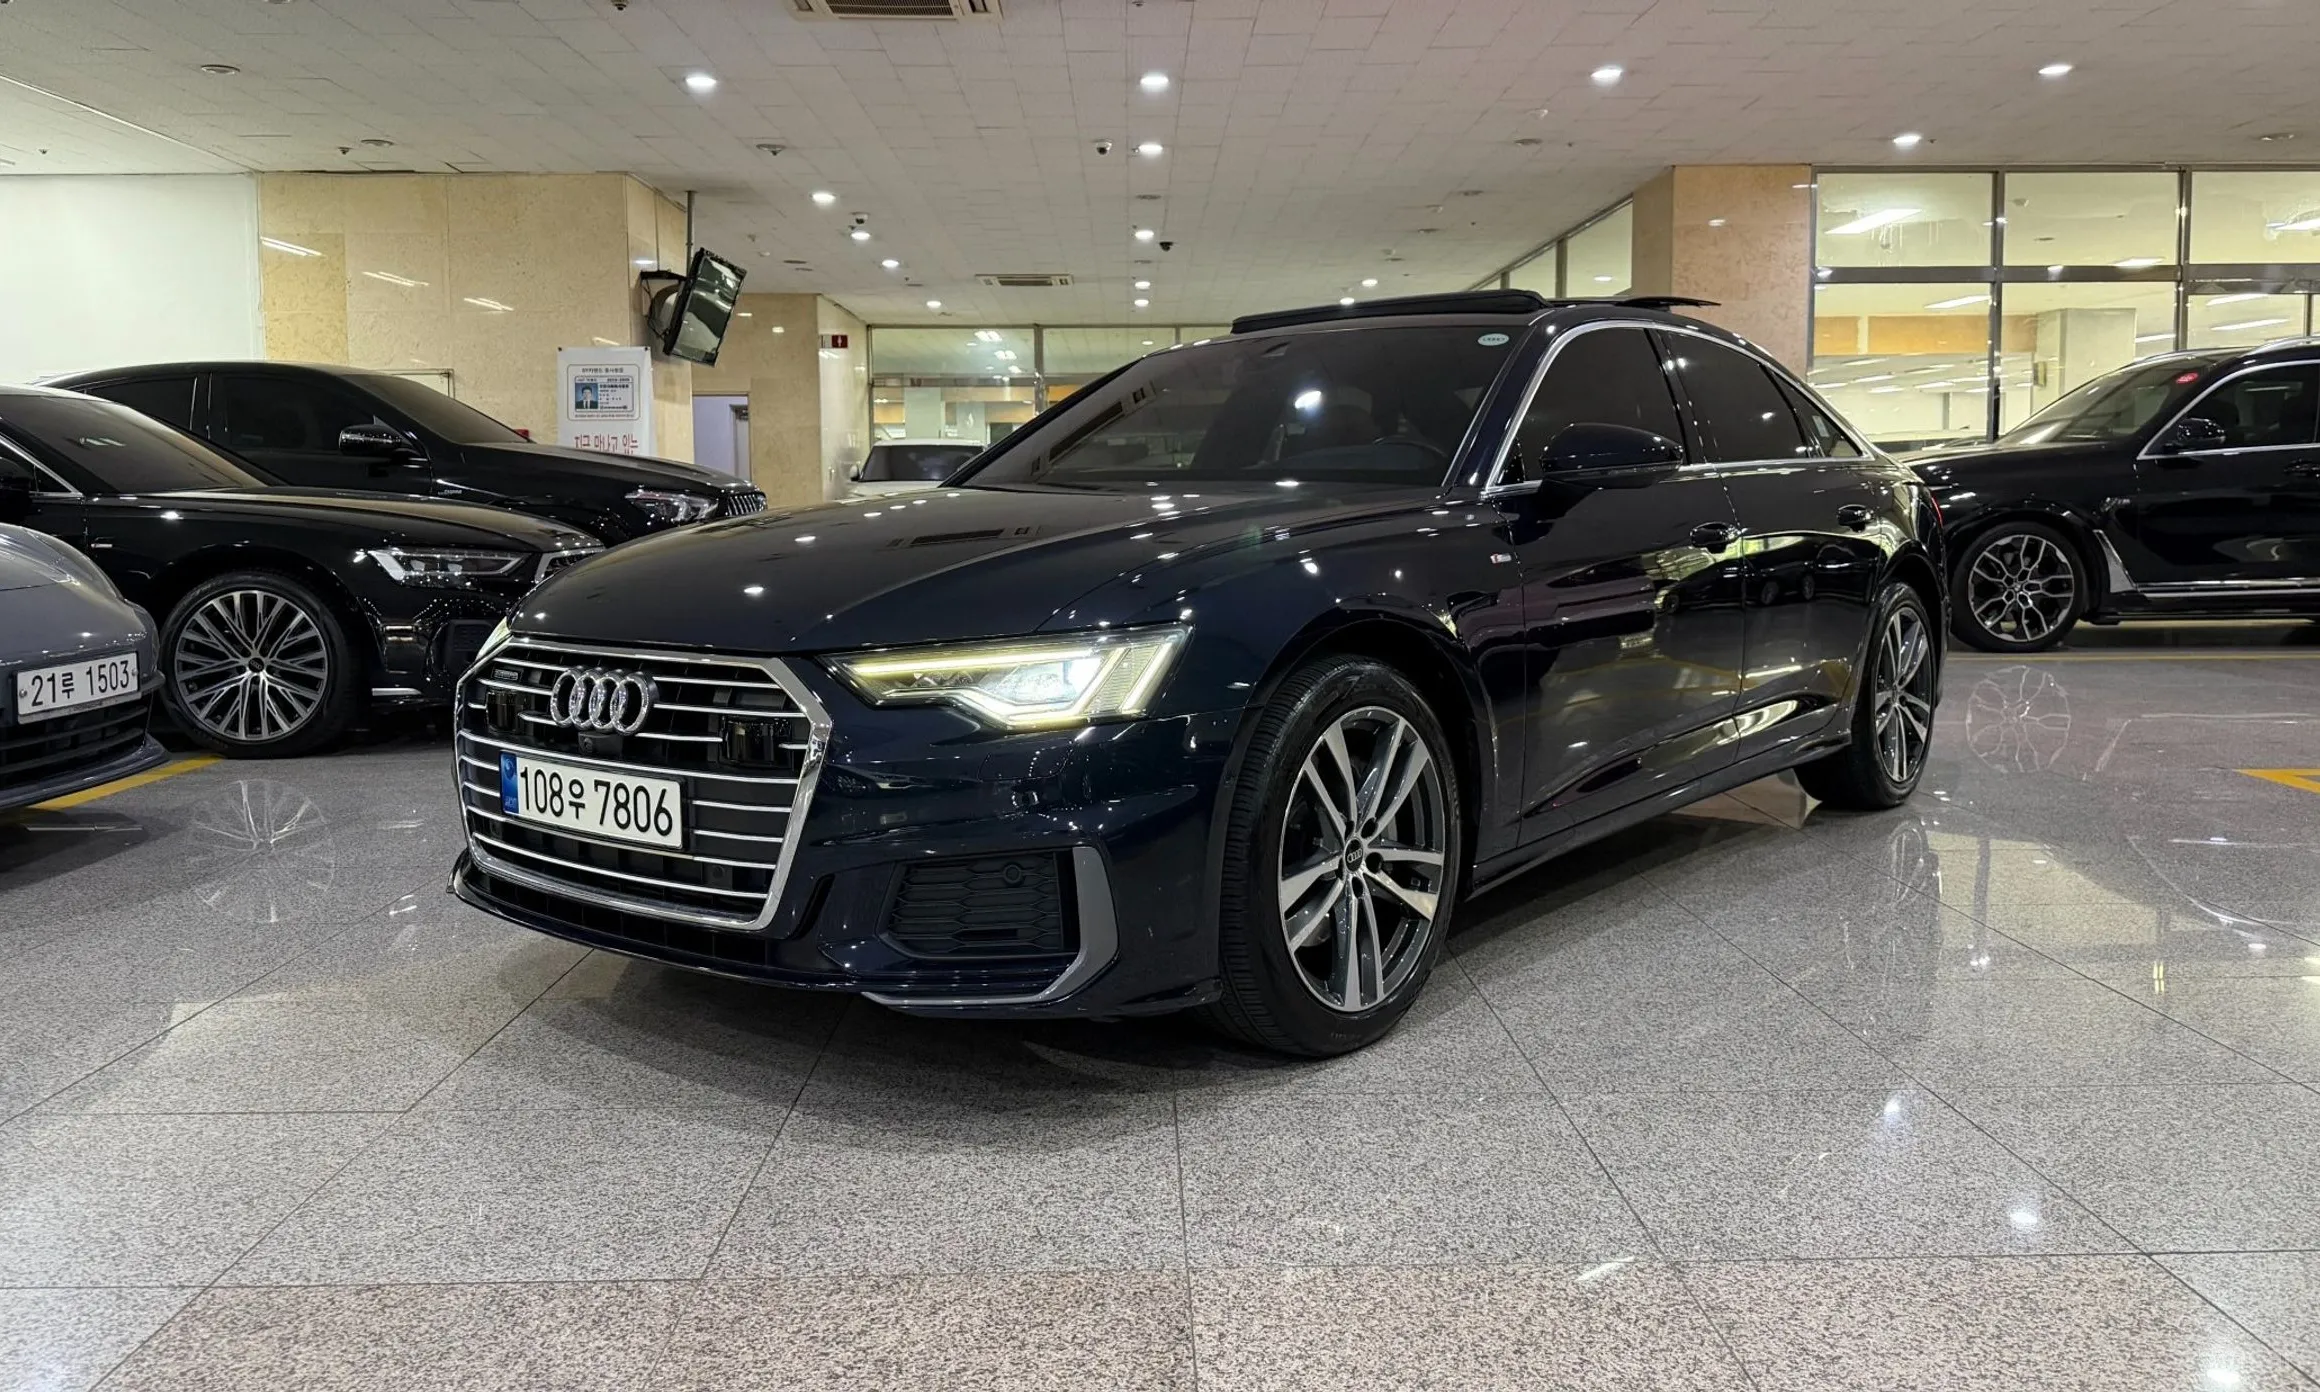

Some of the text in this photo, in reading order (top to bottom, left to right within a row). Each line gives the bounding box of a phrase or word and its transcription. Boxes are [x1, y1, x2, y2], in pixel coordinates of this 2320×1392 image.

[31, 660, 129, 707] 21루 1503
[520, 766, 673, 837] 108우 7806
